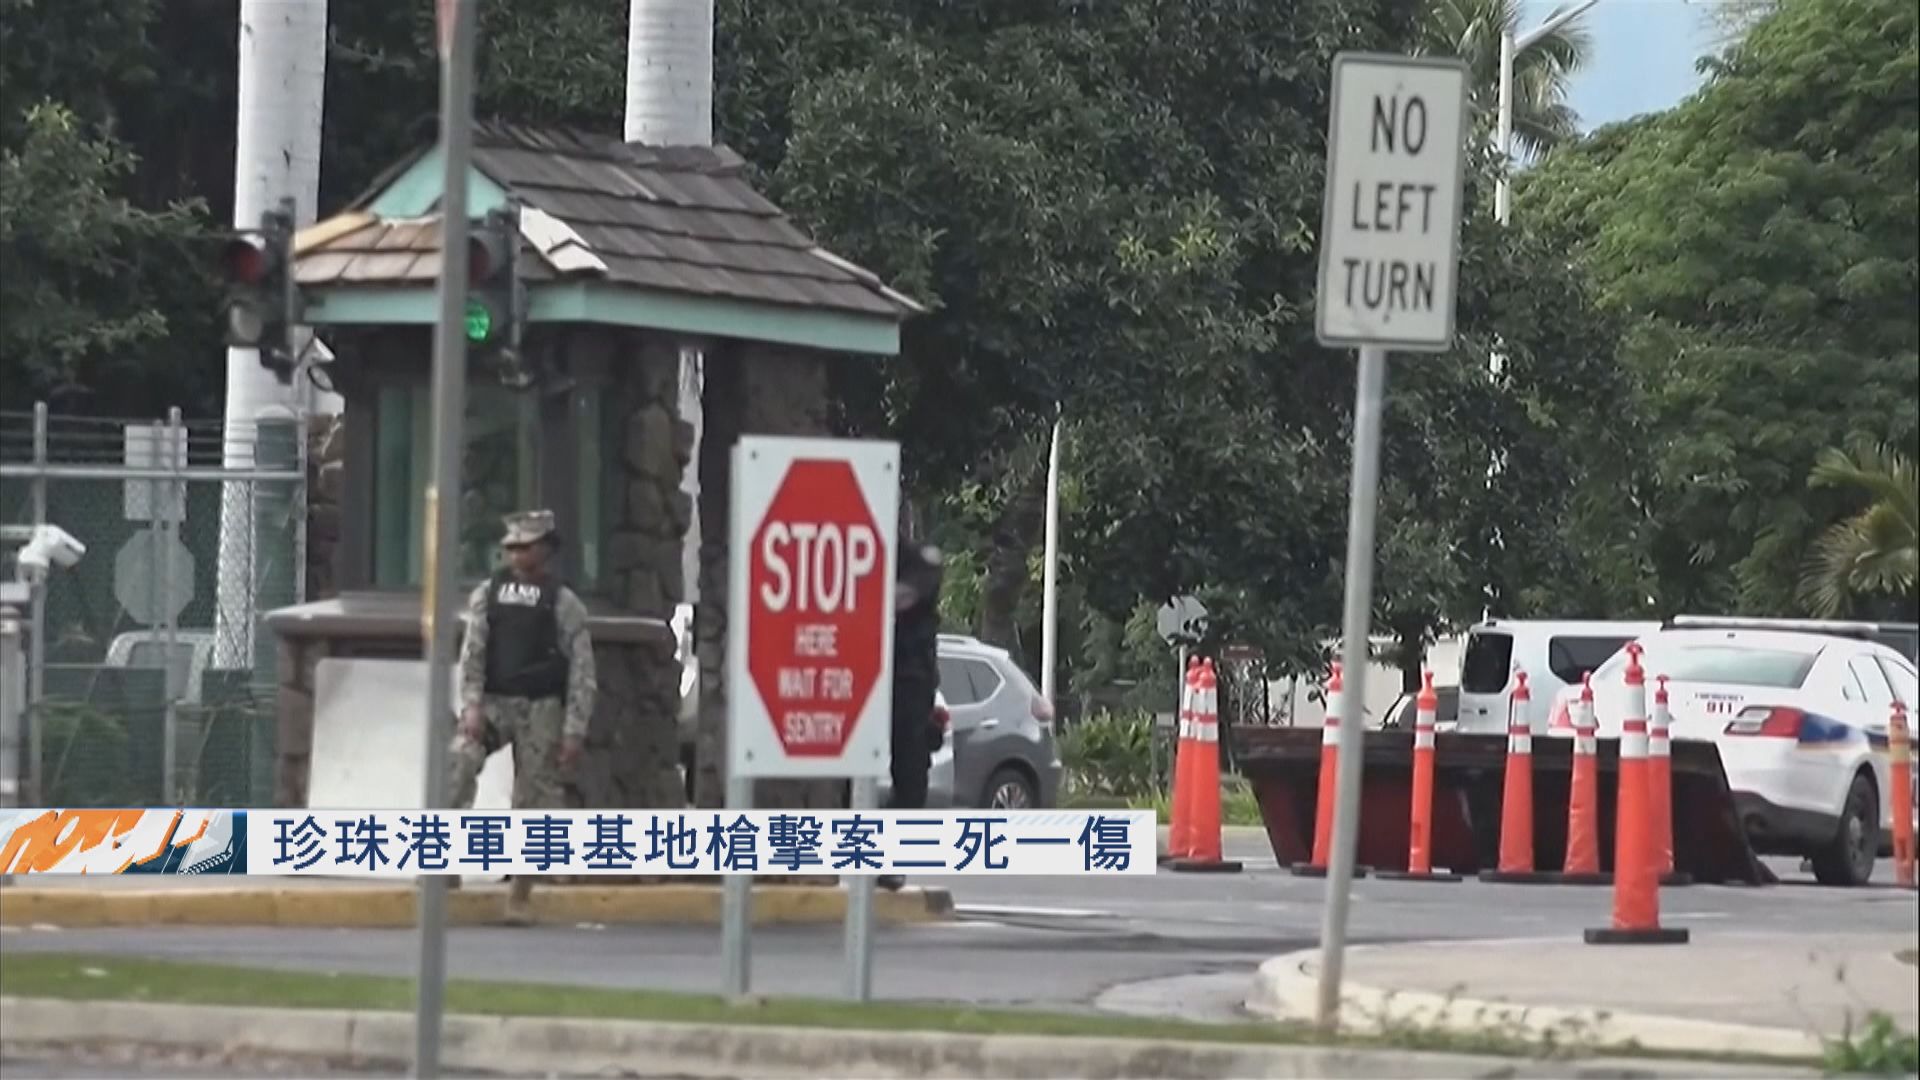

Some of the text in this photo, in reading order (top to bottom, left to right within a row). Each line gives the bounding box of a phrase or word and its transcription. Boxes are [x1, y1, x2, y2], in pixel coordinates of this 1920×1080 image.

[1371, 94, 1426, 156] NO
[1352, 181, 1437, 234] LEFT
[1343, 257, 1435, 311] TURN
[761, 521, 877, 613] STOP
[795, 624, 838, 656] HERE
[778, 667, 854, 700] WAIT FOR
[784, 711, 846, 743] SENTRY
[1706, 701, 1732, 714] 911
